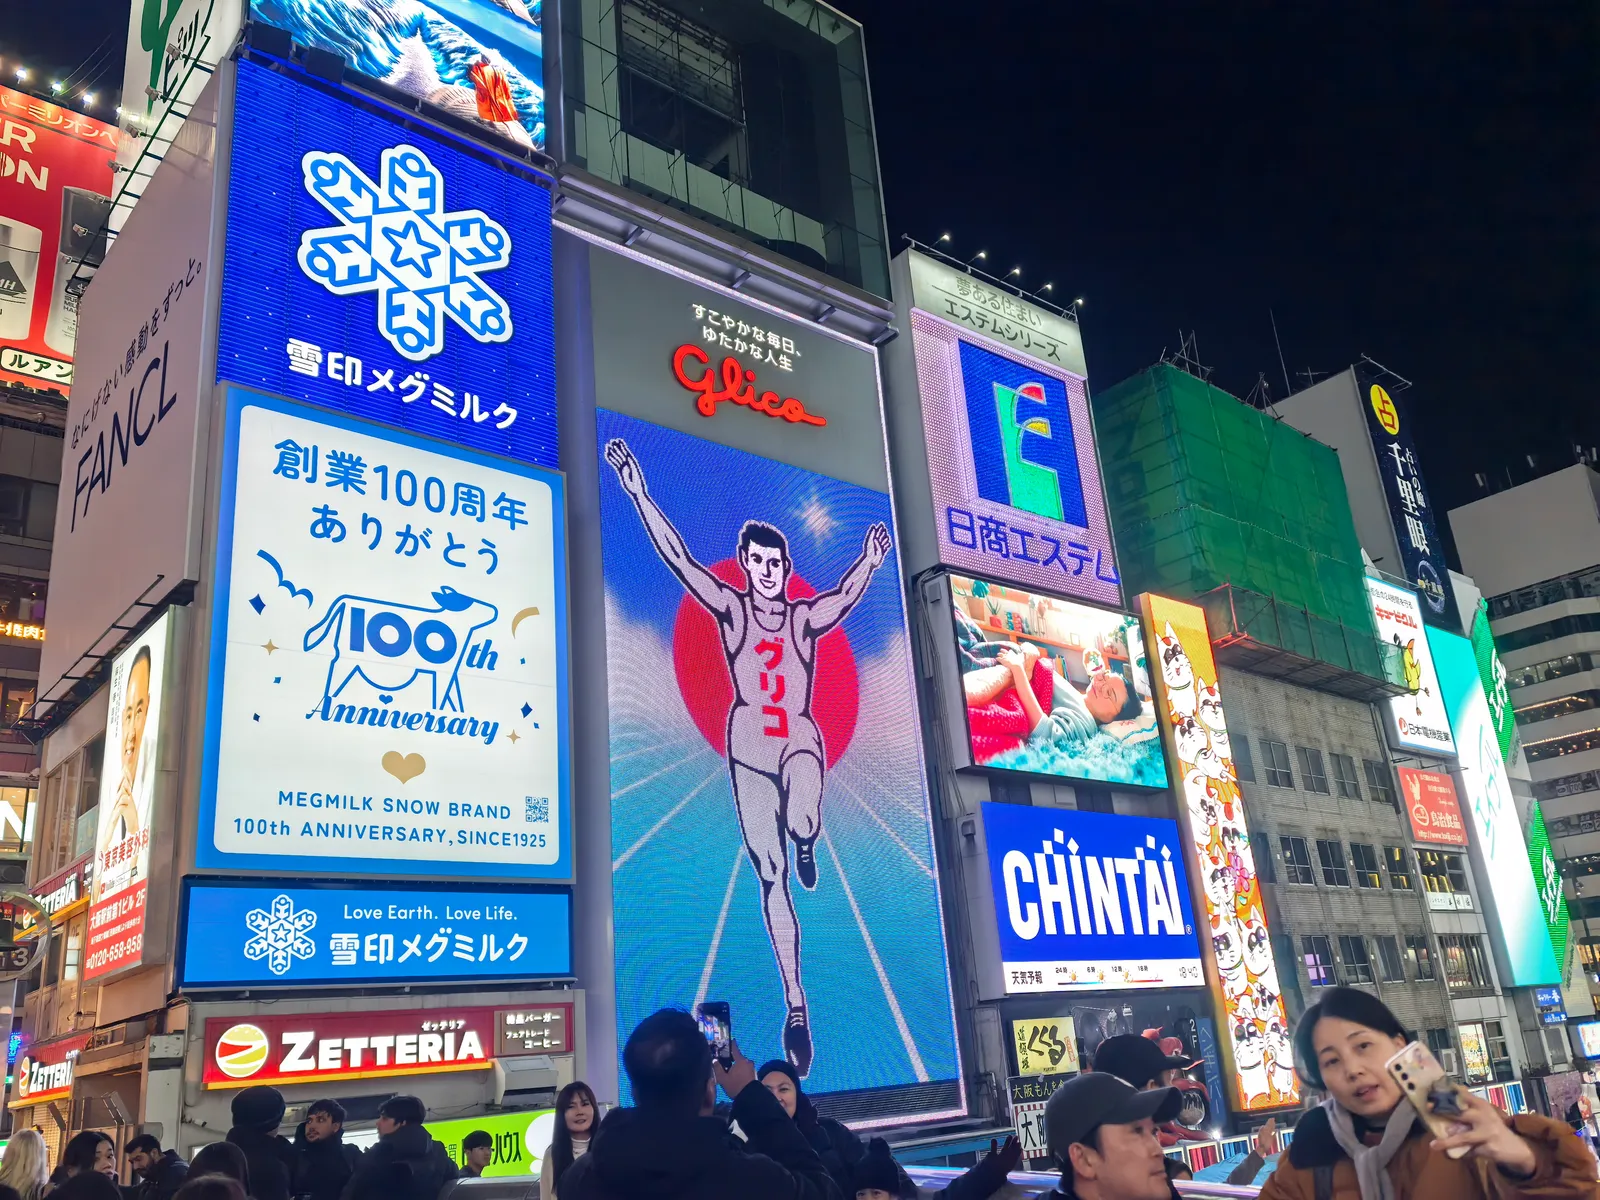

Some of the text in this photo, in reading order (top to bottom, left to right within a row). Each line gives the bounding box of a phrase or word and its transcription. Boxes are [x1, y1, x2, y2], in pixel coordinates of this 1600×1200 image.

[956, 276, 1042, 327] 夢ある住まい
[71, 258, 202, 449] なにげない感動をずっと。
[692, 303, 801, 357] すこやかな毎日、
[703, 326, 793, 372] ゆたかな人生
[946, 299, 1061, 361] エステムシリーズ
[286, 337, 518, 430] 雪印メグミルク
[672, 343, 827, 427] Glico
[1377, 386, 1397, 431] 占
[71, 340, 177, 533] FANCL
[273, 438, 529, 531] 創業100周年
[1386, 442, 1431, 557] 千里眼
[310, 503, 498, 575] ありがとう
[947, 507, 1121, 585] 日商エステム
[753, 636, 789, 739] グリコ
[306, 694, 499, 746] Anniversary
[234, 817, 290, 836] 100th
[278, 790, 511, 820] MEGMILK SNOW BRAND
[1002, 830, 1186, 941] CHINTAI
[344, 904, 518, 921] Love Earth. Love Life.
[329, 927, 528, 966] 雪印メグミルク
[1011, 970, 1043, 985] 天気予報
[421, 1019, 466, 1032] ゼッテリア
[505, 1029, 551, 1040] フェアトレード
[524, 1039, 561, 1049] コーヒー
[1028, 1024, 1067, 1067] くくる
[279, 1031, 485, 1073] ZETTERIA
